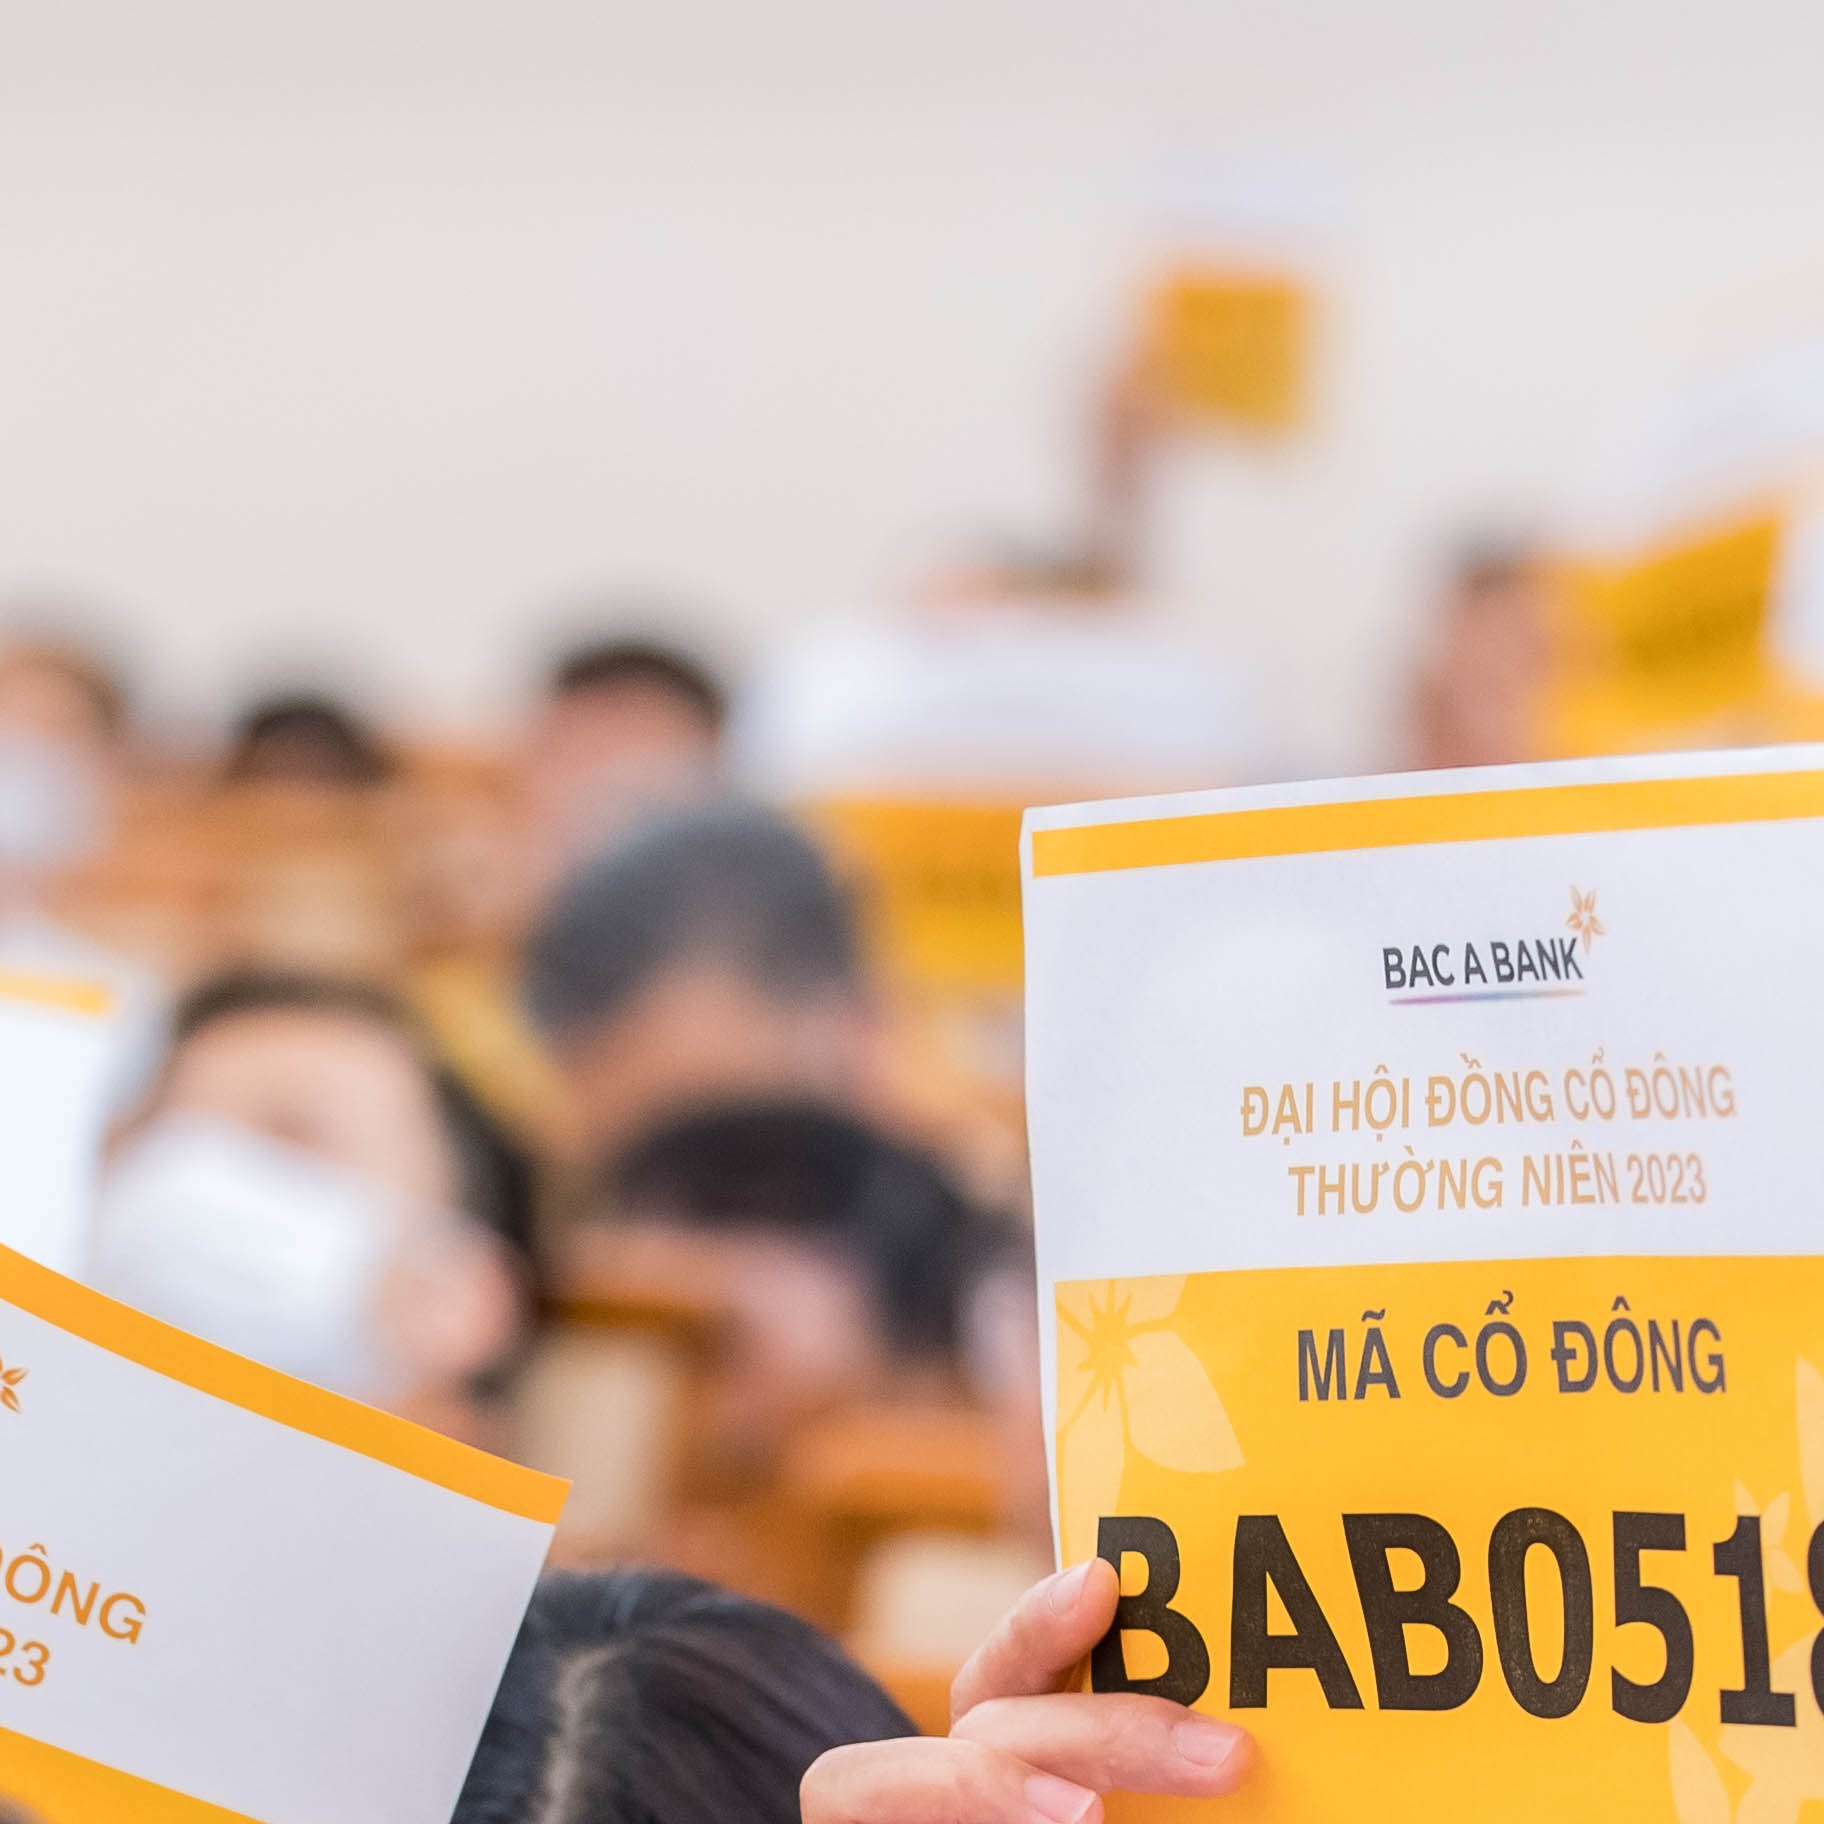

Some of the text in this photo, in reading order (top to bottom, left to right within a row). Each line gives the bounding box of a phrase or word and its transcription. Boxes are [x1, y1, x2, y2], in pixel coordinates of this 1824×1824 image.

[1382, 937, 1583, 989] BAC A BANK
[1240, 1048, 1737, 1145] ĐẠI HỘI ĐỒNG CỔ ĐÔNG
[1288, 1139, 1706, 1216] THƯỜNG NIÊN 2023
[1297, 1290, 1726, 1401] MÃ CỔ ĐÔNG
